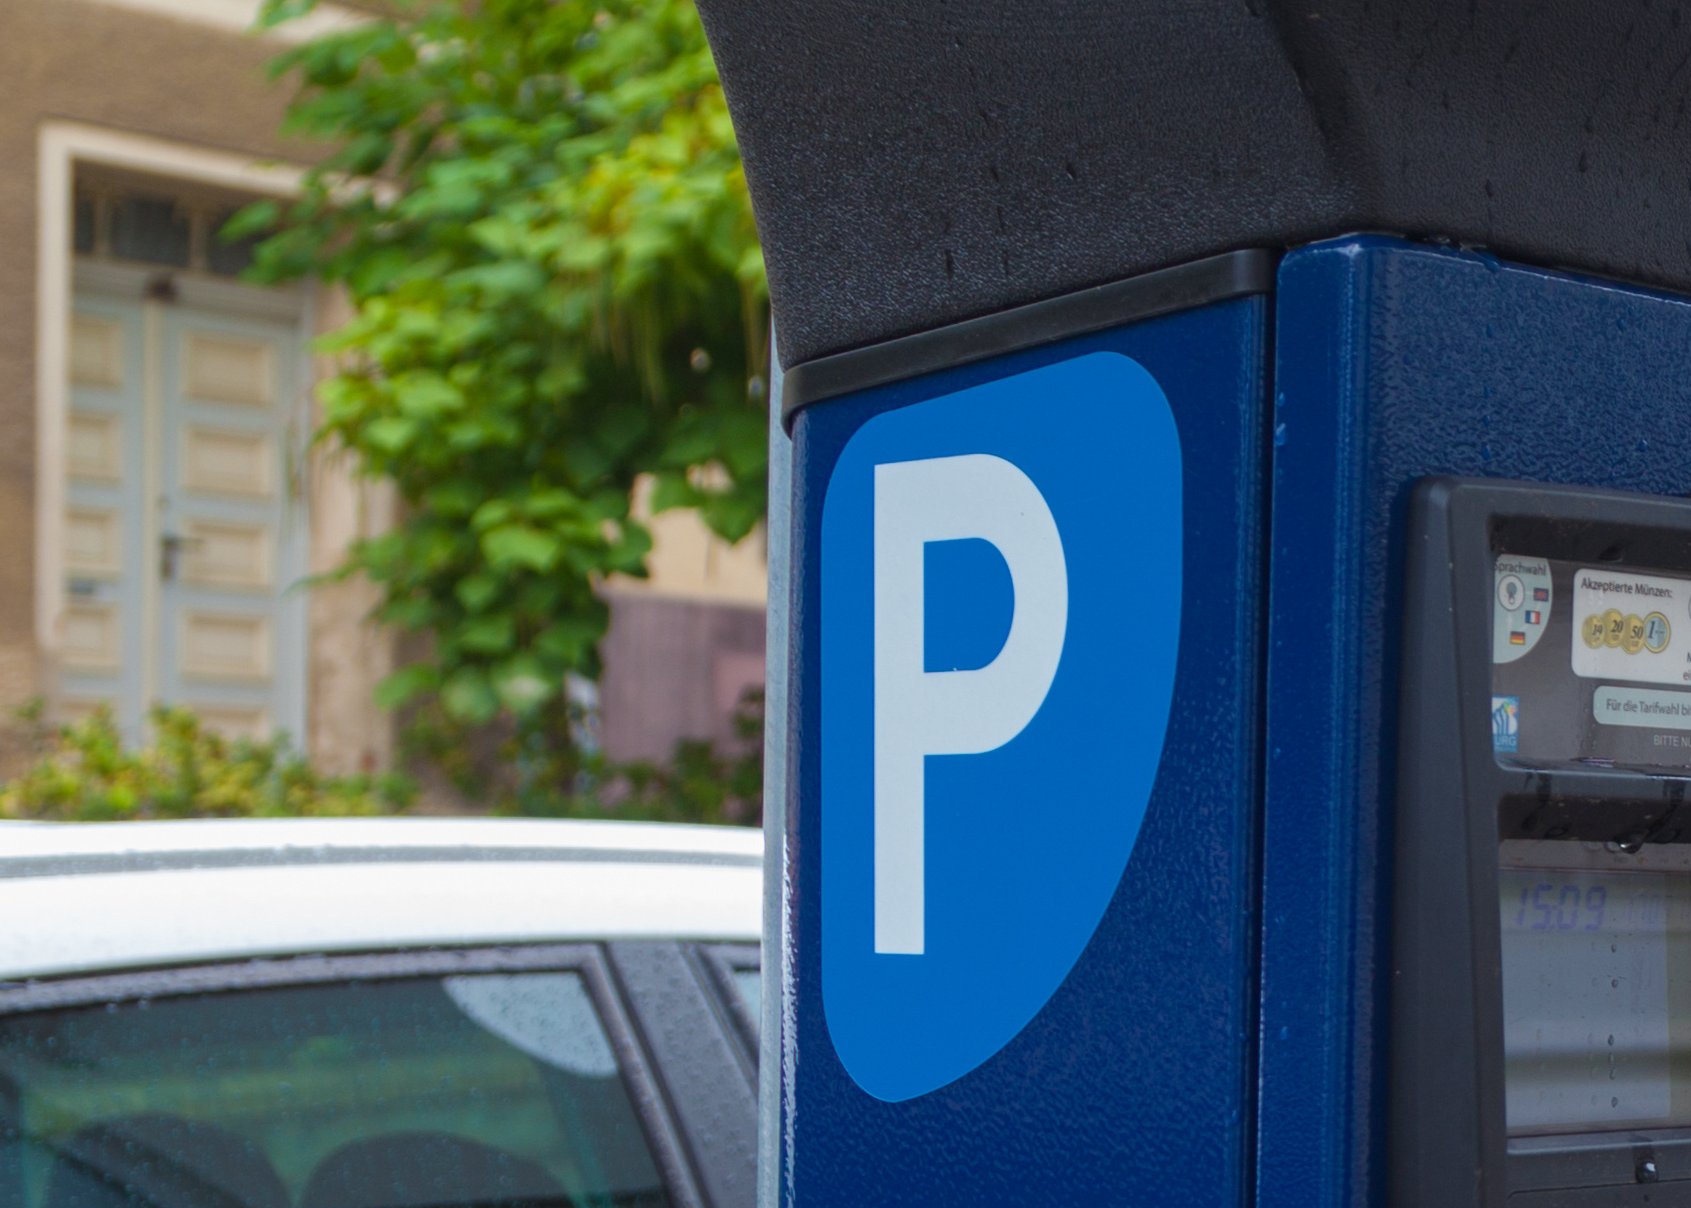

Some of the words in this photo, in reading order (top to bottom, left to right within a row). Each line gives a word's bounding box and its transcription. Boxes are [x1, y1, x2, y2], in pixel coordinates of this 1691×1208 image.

[1581, 577, 1633, 595] Akzeptierte
[1635, 580, 1673, 598] Münzen:
[1610, 619, 1624, 634] 20
[1630, 625, 1644, 640] 50
[873, 453, 1070, 956] P
[1606, 698, 1621, 711] Für
[1623, 700, 1638, 713] die
[1640, 701, 1679, 716] Tarifwahl
[1653, 734, 1680, 748] BITTE
